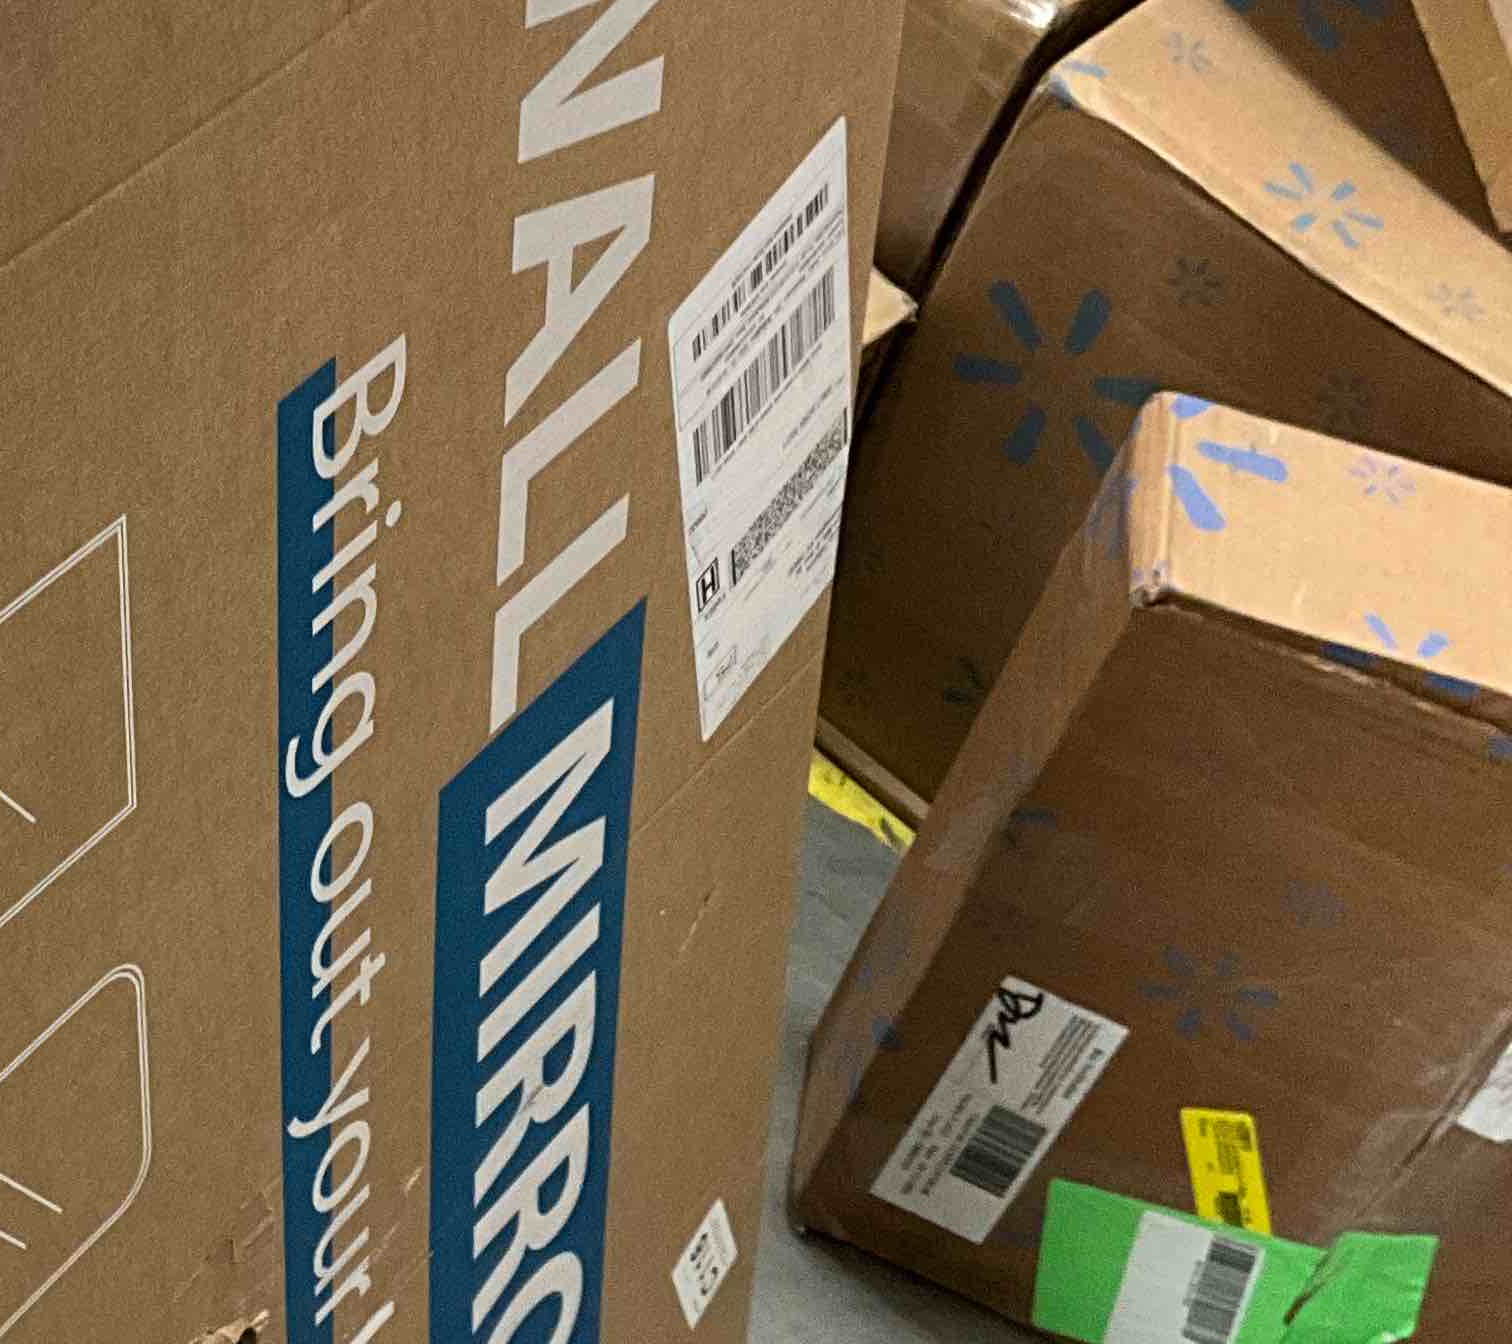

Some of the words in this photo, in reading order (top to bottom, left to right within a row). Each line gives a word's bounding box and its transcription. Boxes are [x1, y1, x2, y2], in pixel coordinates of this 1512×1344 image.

[285, 332, 408, 799] Bring
[310, 800, 386, 1056] out
[287, 1035, 372, 1328] your
